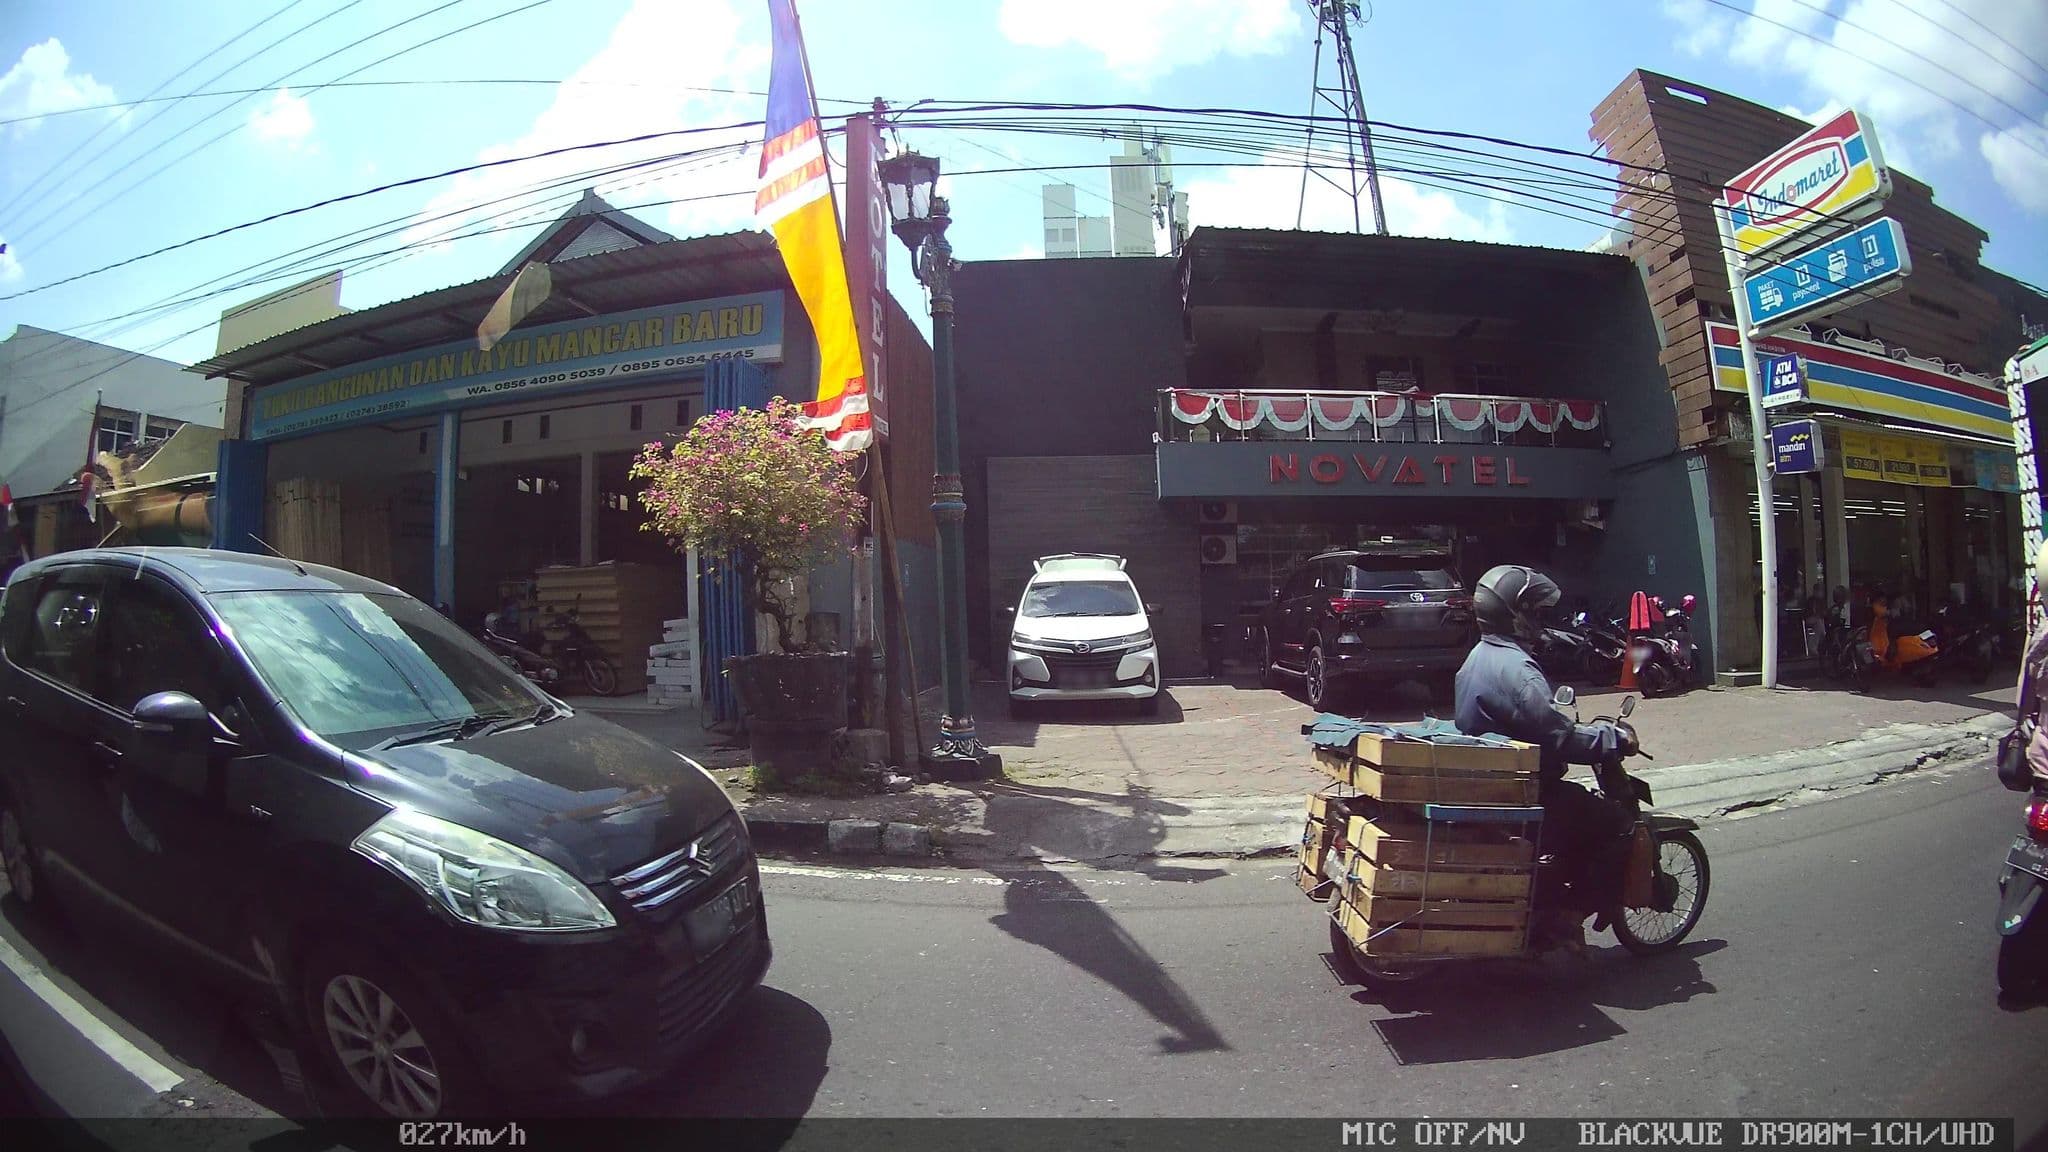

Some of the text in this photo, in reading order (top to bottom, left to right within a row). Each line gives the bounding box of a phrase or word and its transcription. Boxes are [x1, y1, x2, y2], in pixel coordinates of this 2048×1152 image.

[1757, 151, 1841, 218] Indomaret
[1792, 281, 1821, 302] payment
[409, 352, 457, 386] DAN
[461, 339, 530, 377] KAYU
[671, 303, 764, 345] BARU
[467, 385, 491, 396] WA.
[495, 379, 527, 391] 0856
[530, 373, 566, 385] 4090
[570, 367, 606, 380] 5039
[621, 360, 660, 373] 0895
[664, 353, 706, 367] 0684
[1776, 360, 1792, 375] ATM
[1781, 371, 1798, 387] BCA
[1269, 453, 1531, 485] NOVATEL
